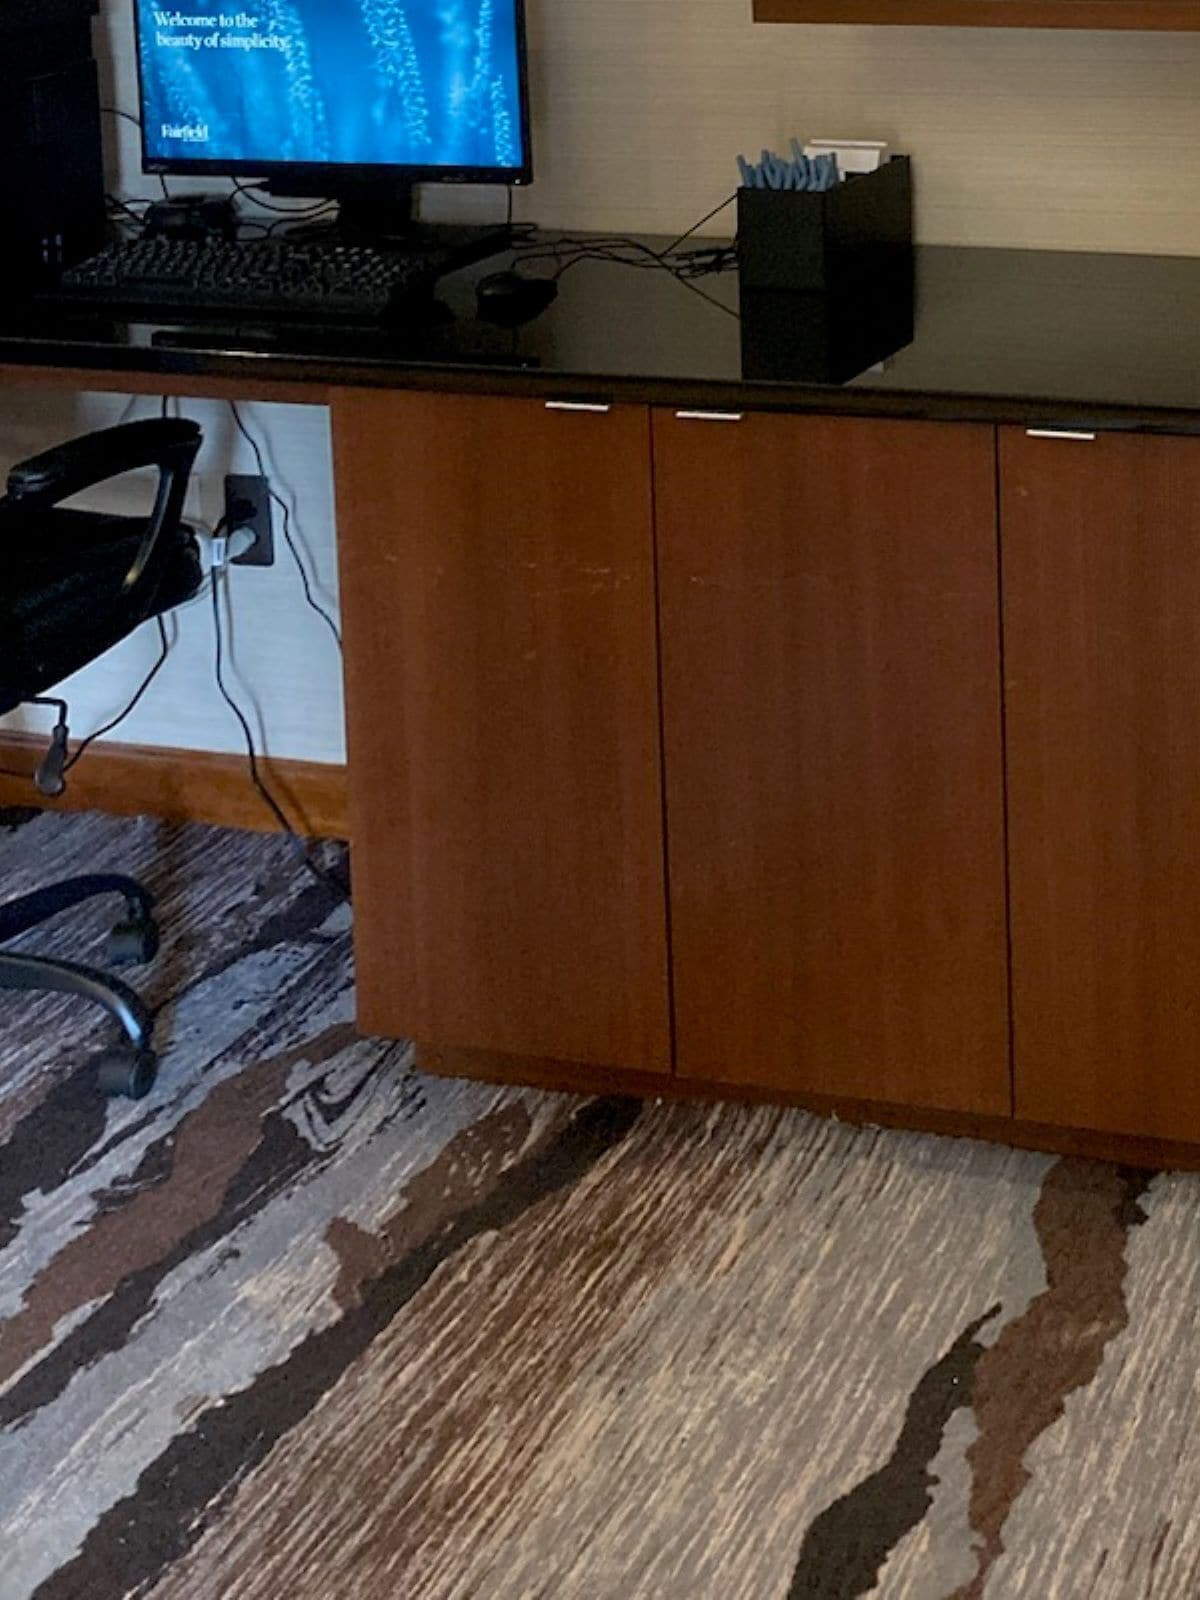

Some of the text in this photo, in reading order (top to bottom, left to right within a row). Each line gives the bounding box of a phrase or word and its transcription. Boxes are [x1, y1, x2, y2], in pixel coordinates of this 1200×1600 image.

[154, 11, 258, 28] Welcome to the
[156, 31, 201, 50] beauty
[203, 31, 220, 48] of
[161, 123, 208, 139] Fairfield
